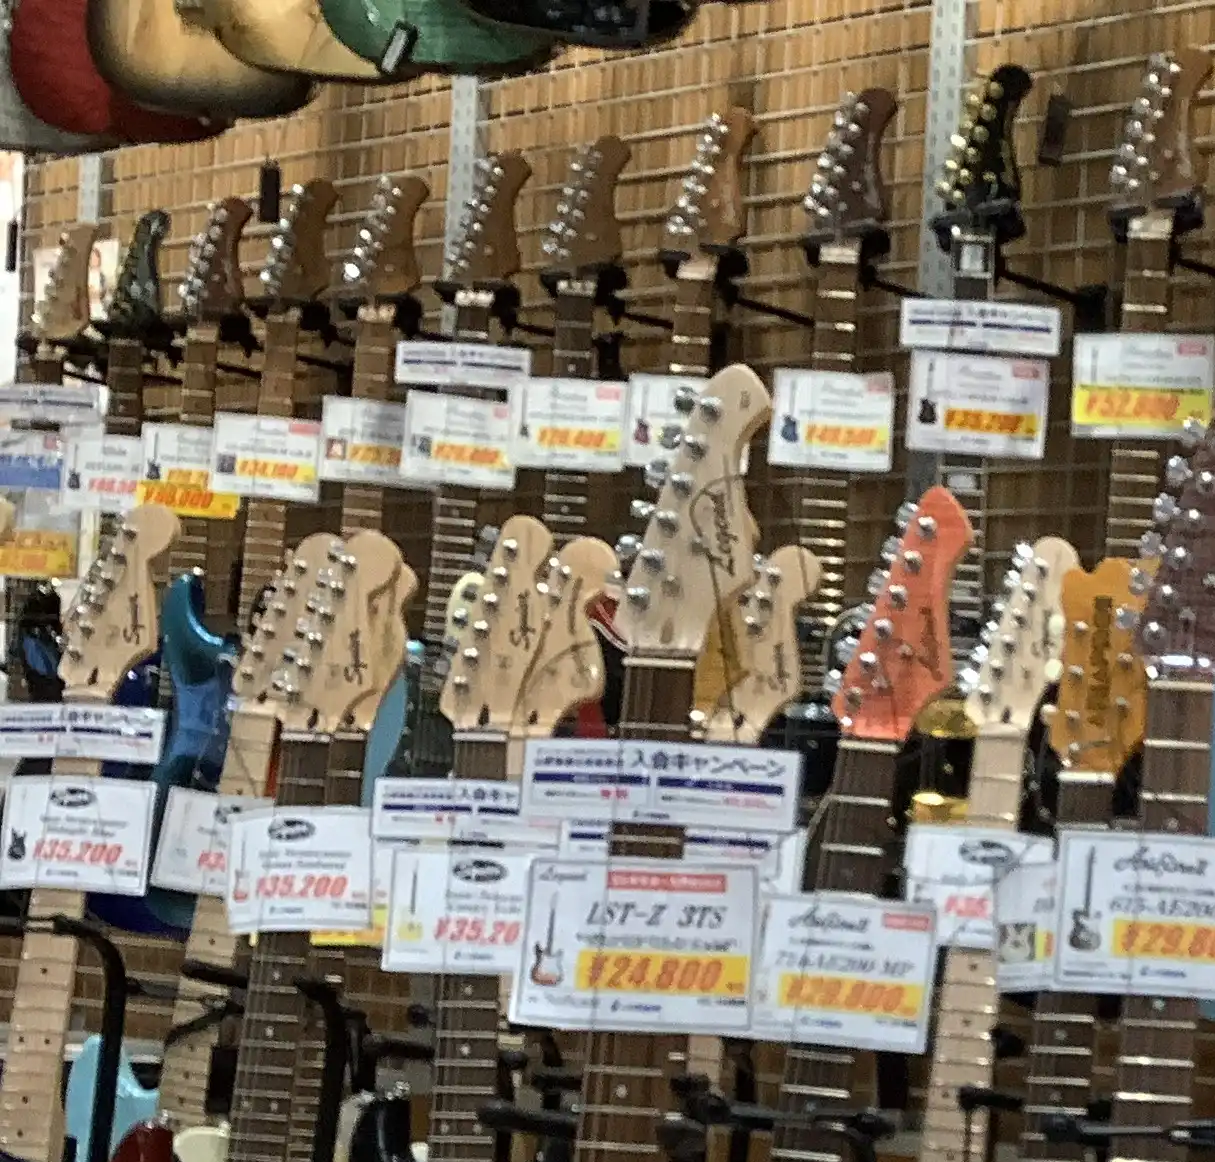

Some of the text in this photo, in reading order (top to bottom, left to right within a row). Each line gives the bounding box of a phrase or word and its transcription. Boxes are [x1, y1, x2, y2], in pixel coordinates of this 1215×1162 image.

[627, 748, 787, 779] 入会キャンペーン
[588, 953, 724, 992] ¥24,800
